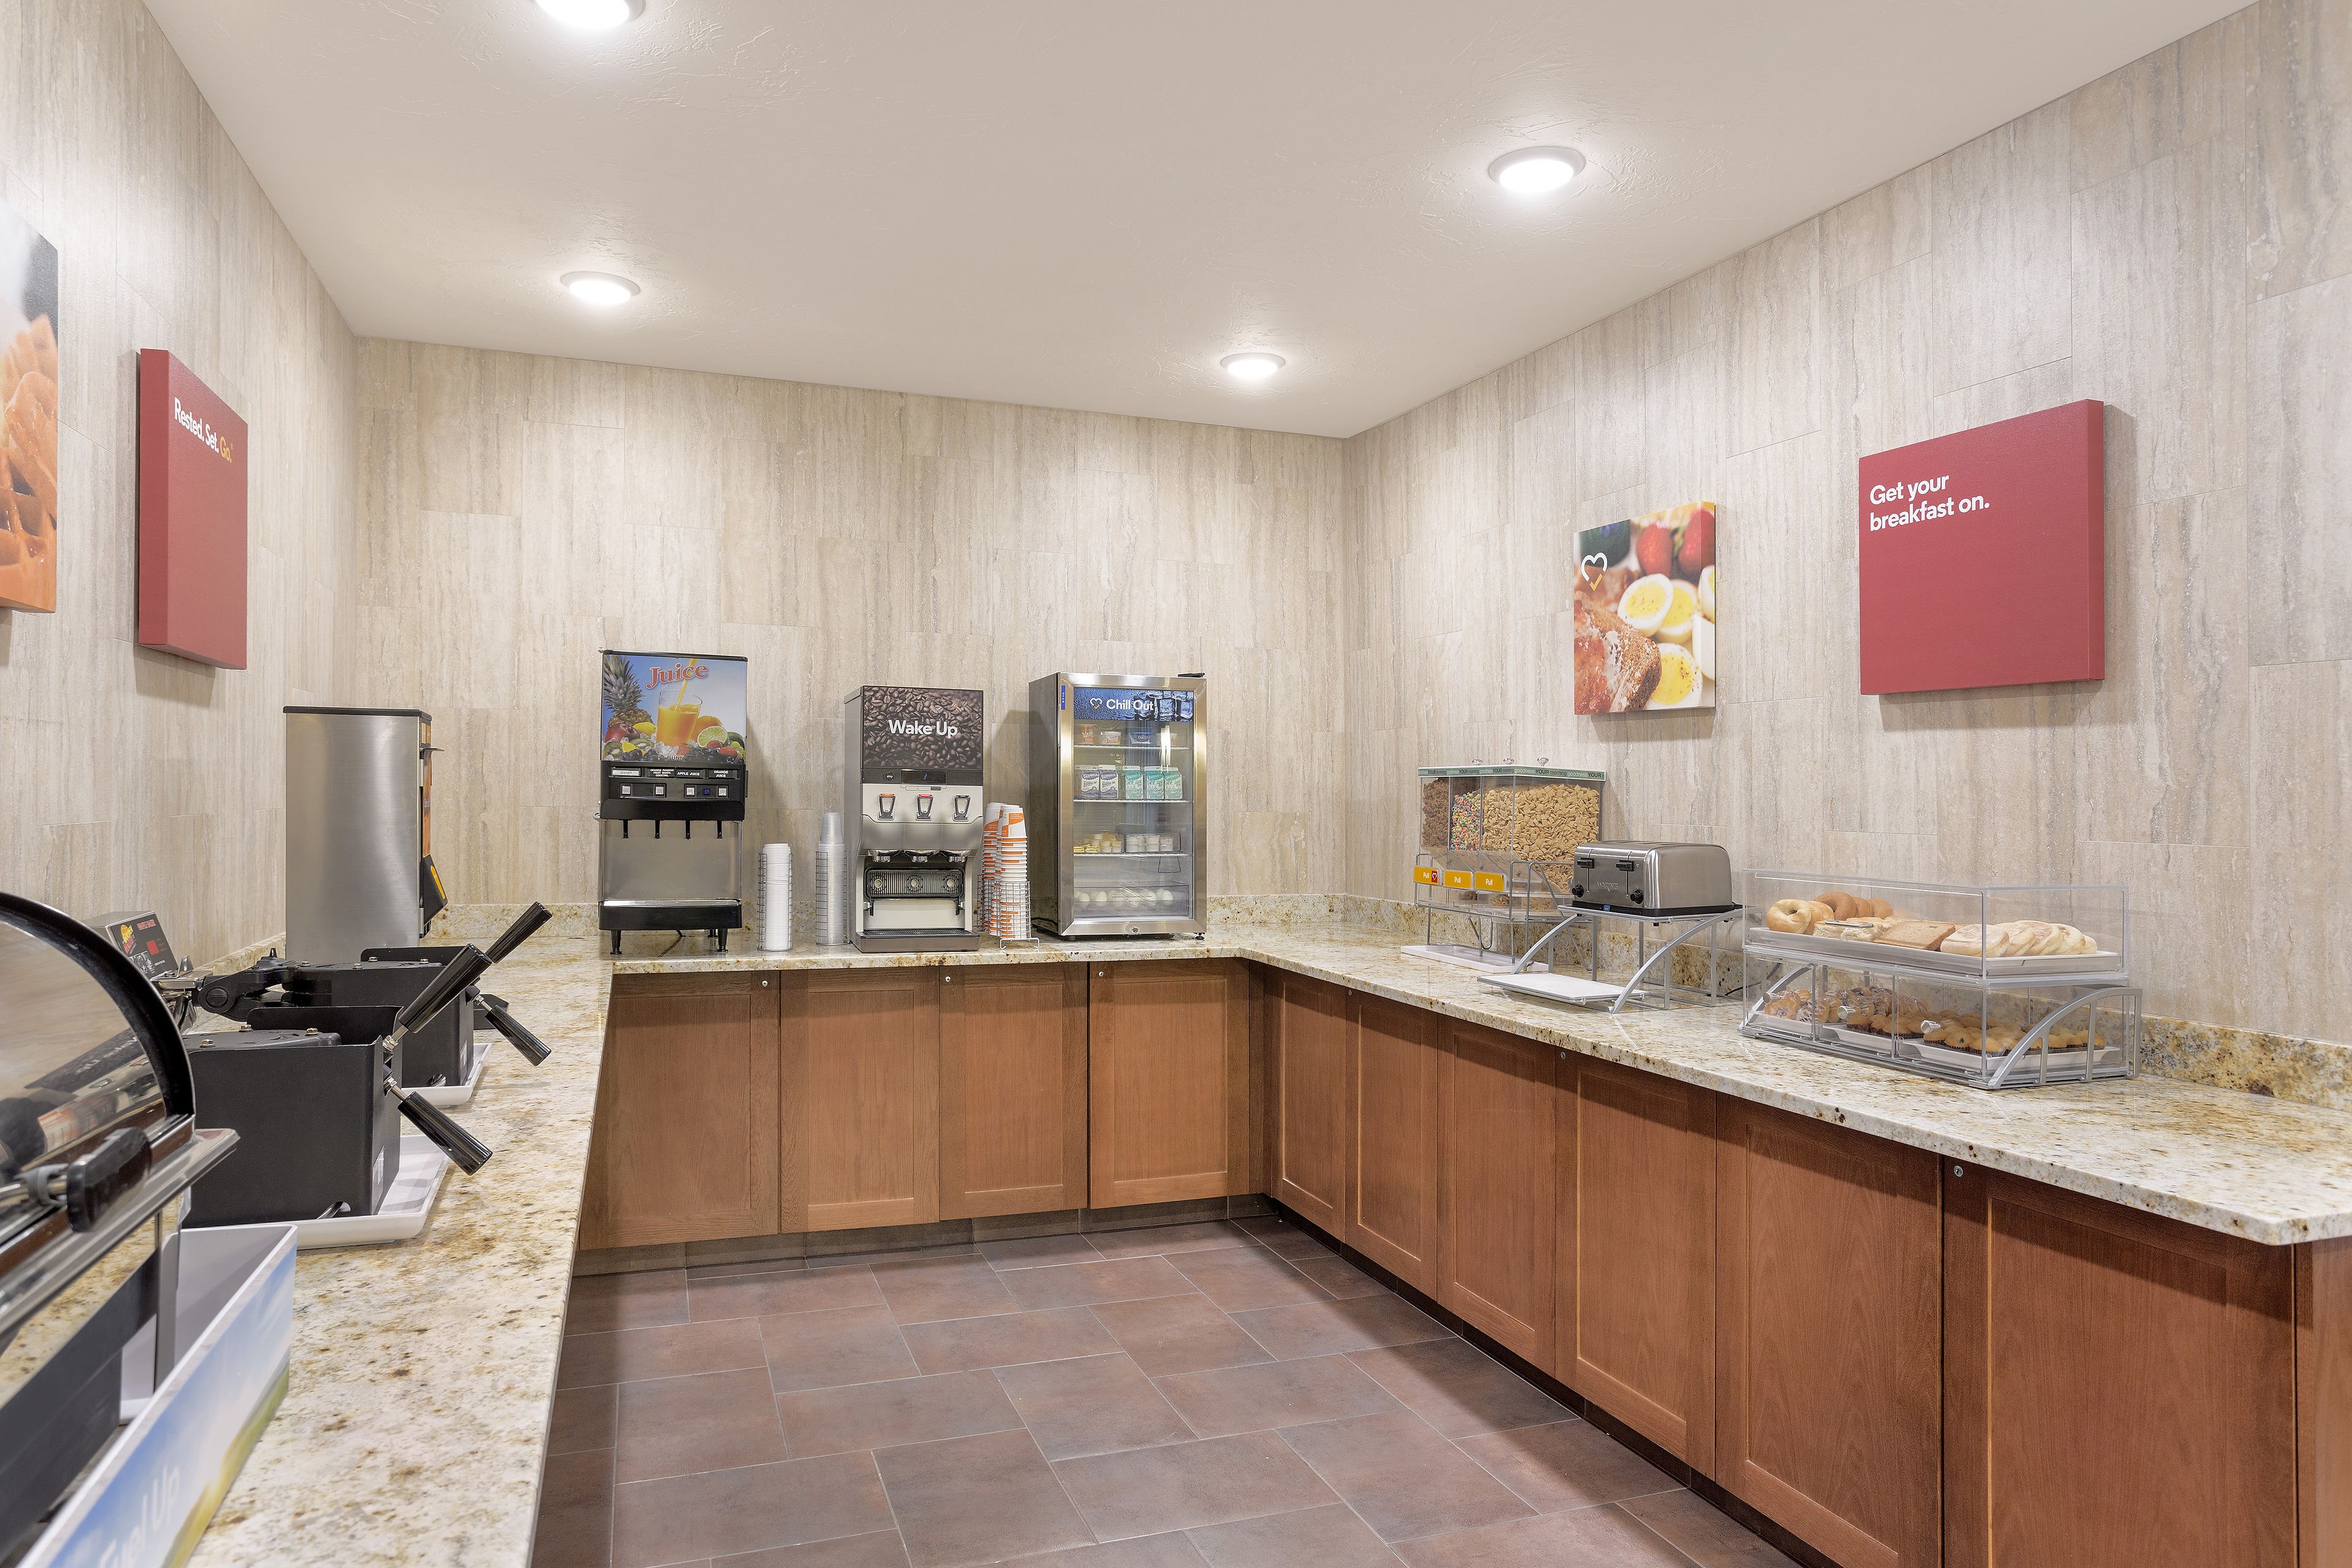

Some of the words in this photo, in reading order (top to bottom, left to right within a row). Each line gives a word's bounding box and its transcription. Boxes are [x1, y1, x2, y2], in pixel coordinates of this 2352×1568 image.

[175, 396, 205, 442] Rested.
[205, 423, 219, 453] Set.
[1869, 481, 1904, 505] Get
[1907, 475, 1950, 502] your
[1870, 497, 1954, 532] breakfast
[1958, 495, 1990, 513] on.
[646, 663, 708, 689] Juice
[1106, 699, 1131, 710] Chill
[1133, 700, 1154, 710] Out
[888, 720, 932, 735] Wake
[936, 721, 958, 739] Up
[151, 1464, 180, 1531] Up
